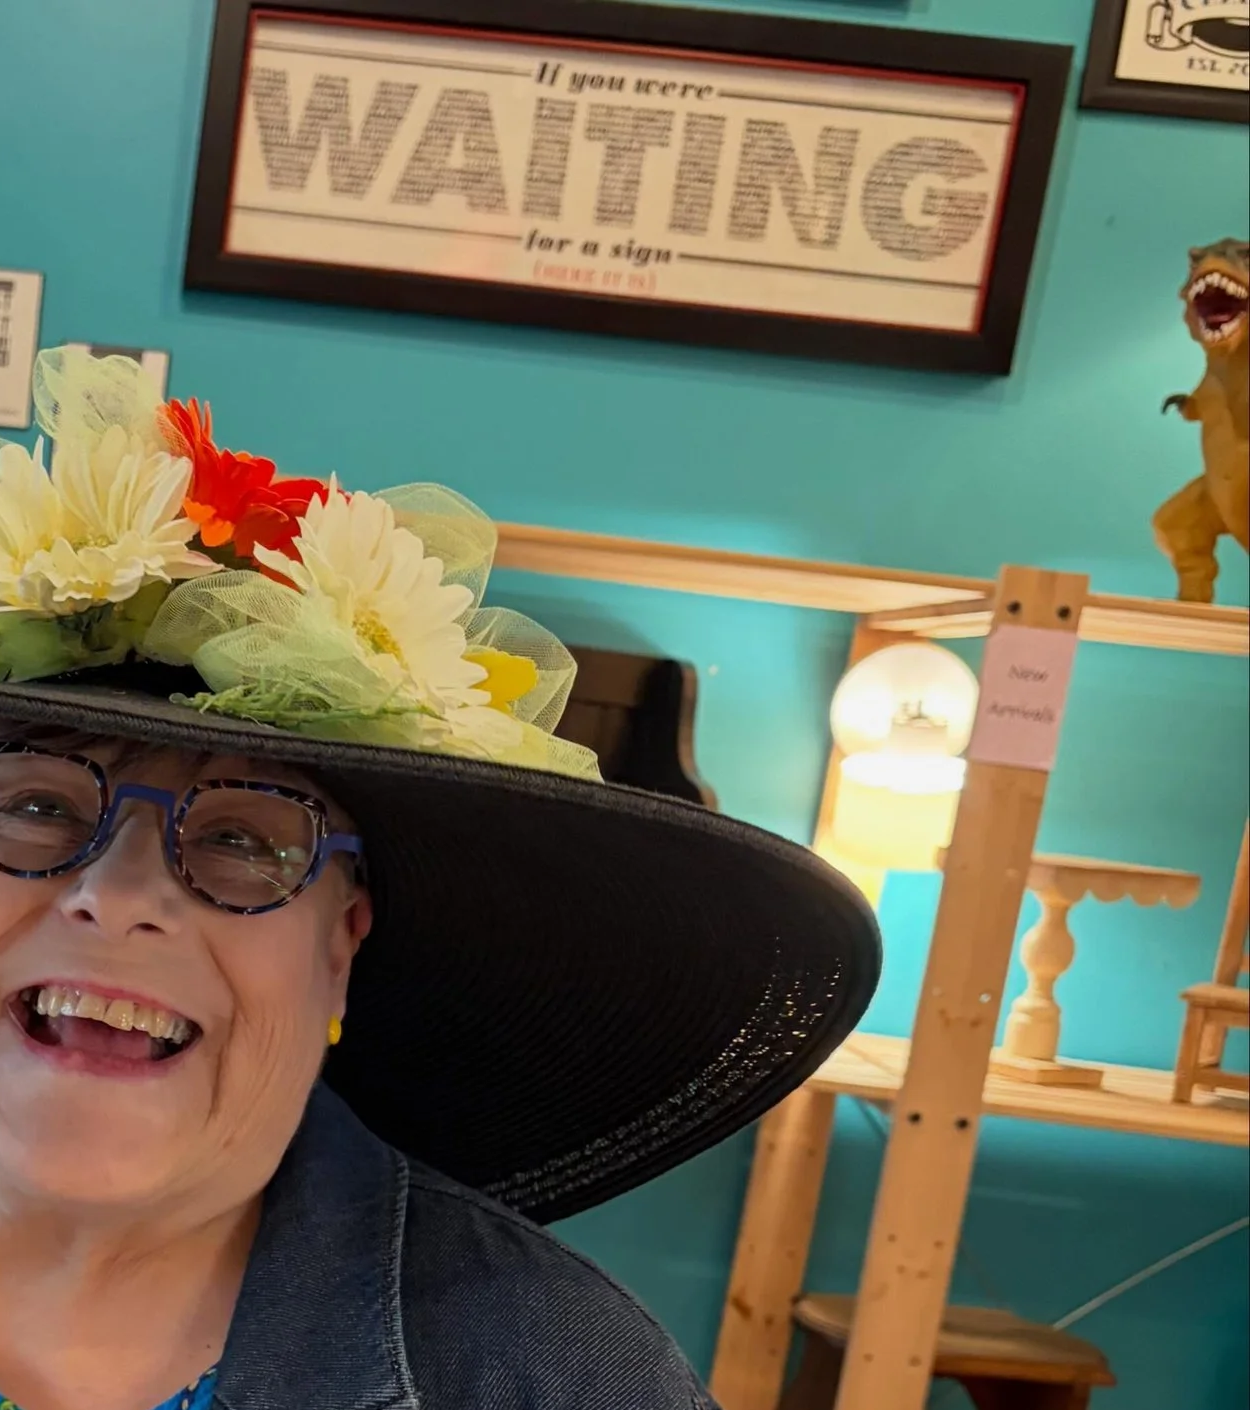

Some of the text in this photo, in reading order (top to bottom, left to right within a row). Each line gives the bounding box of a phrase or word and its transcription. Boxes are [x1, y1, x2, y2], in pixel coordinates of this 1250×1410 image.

[536, 60, 715, 101] If you were
[249, 65, 989, 263] WAITING
[525, 228, 672, 268] for a sign
